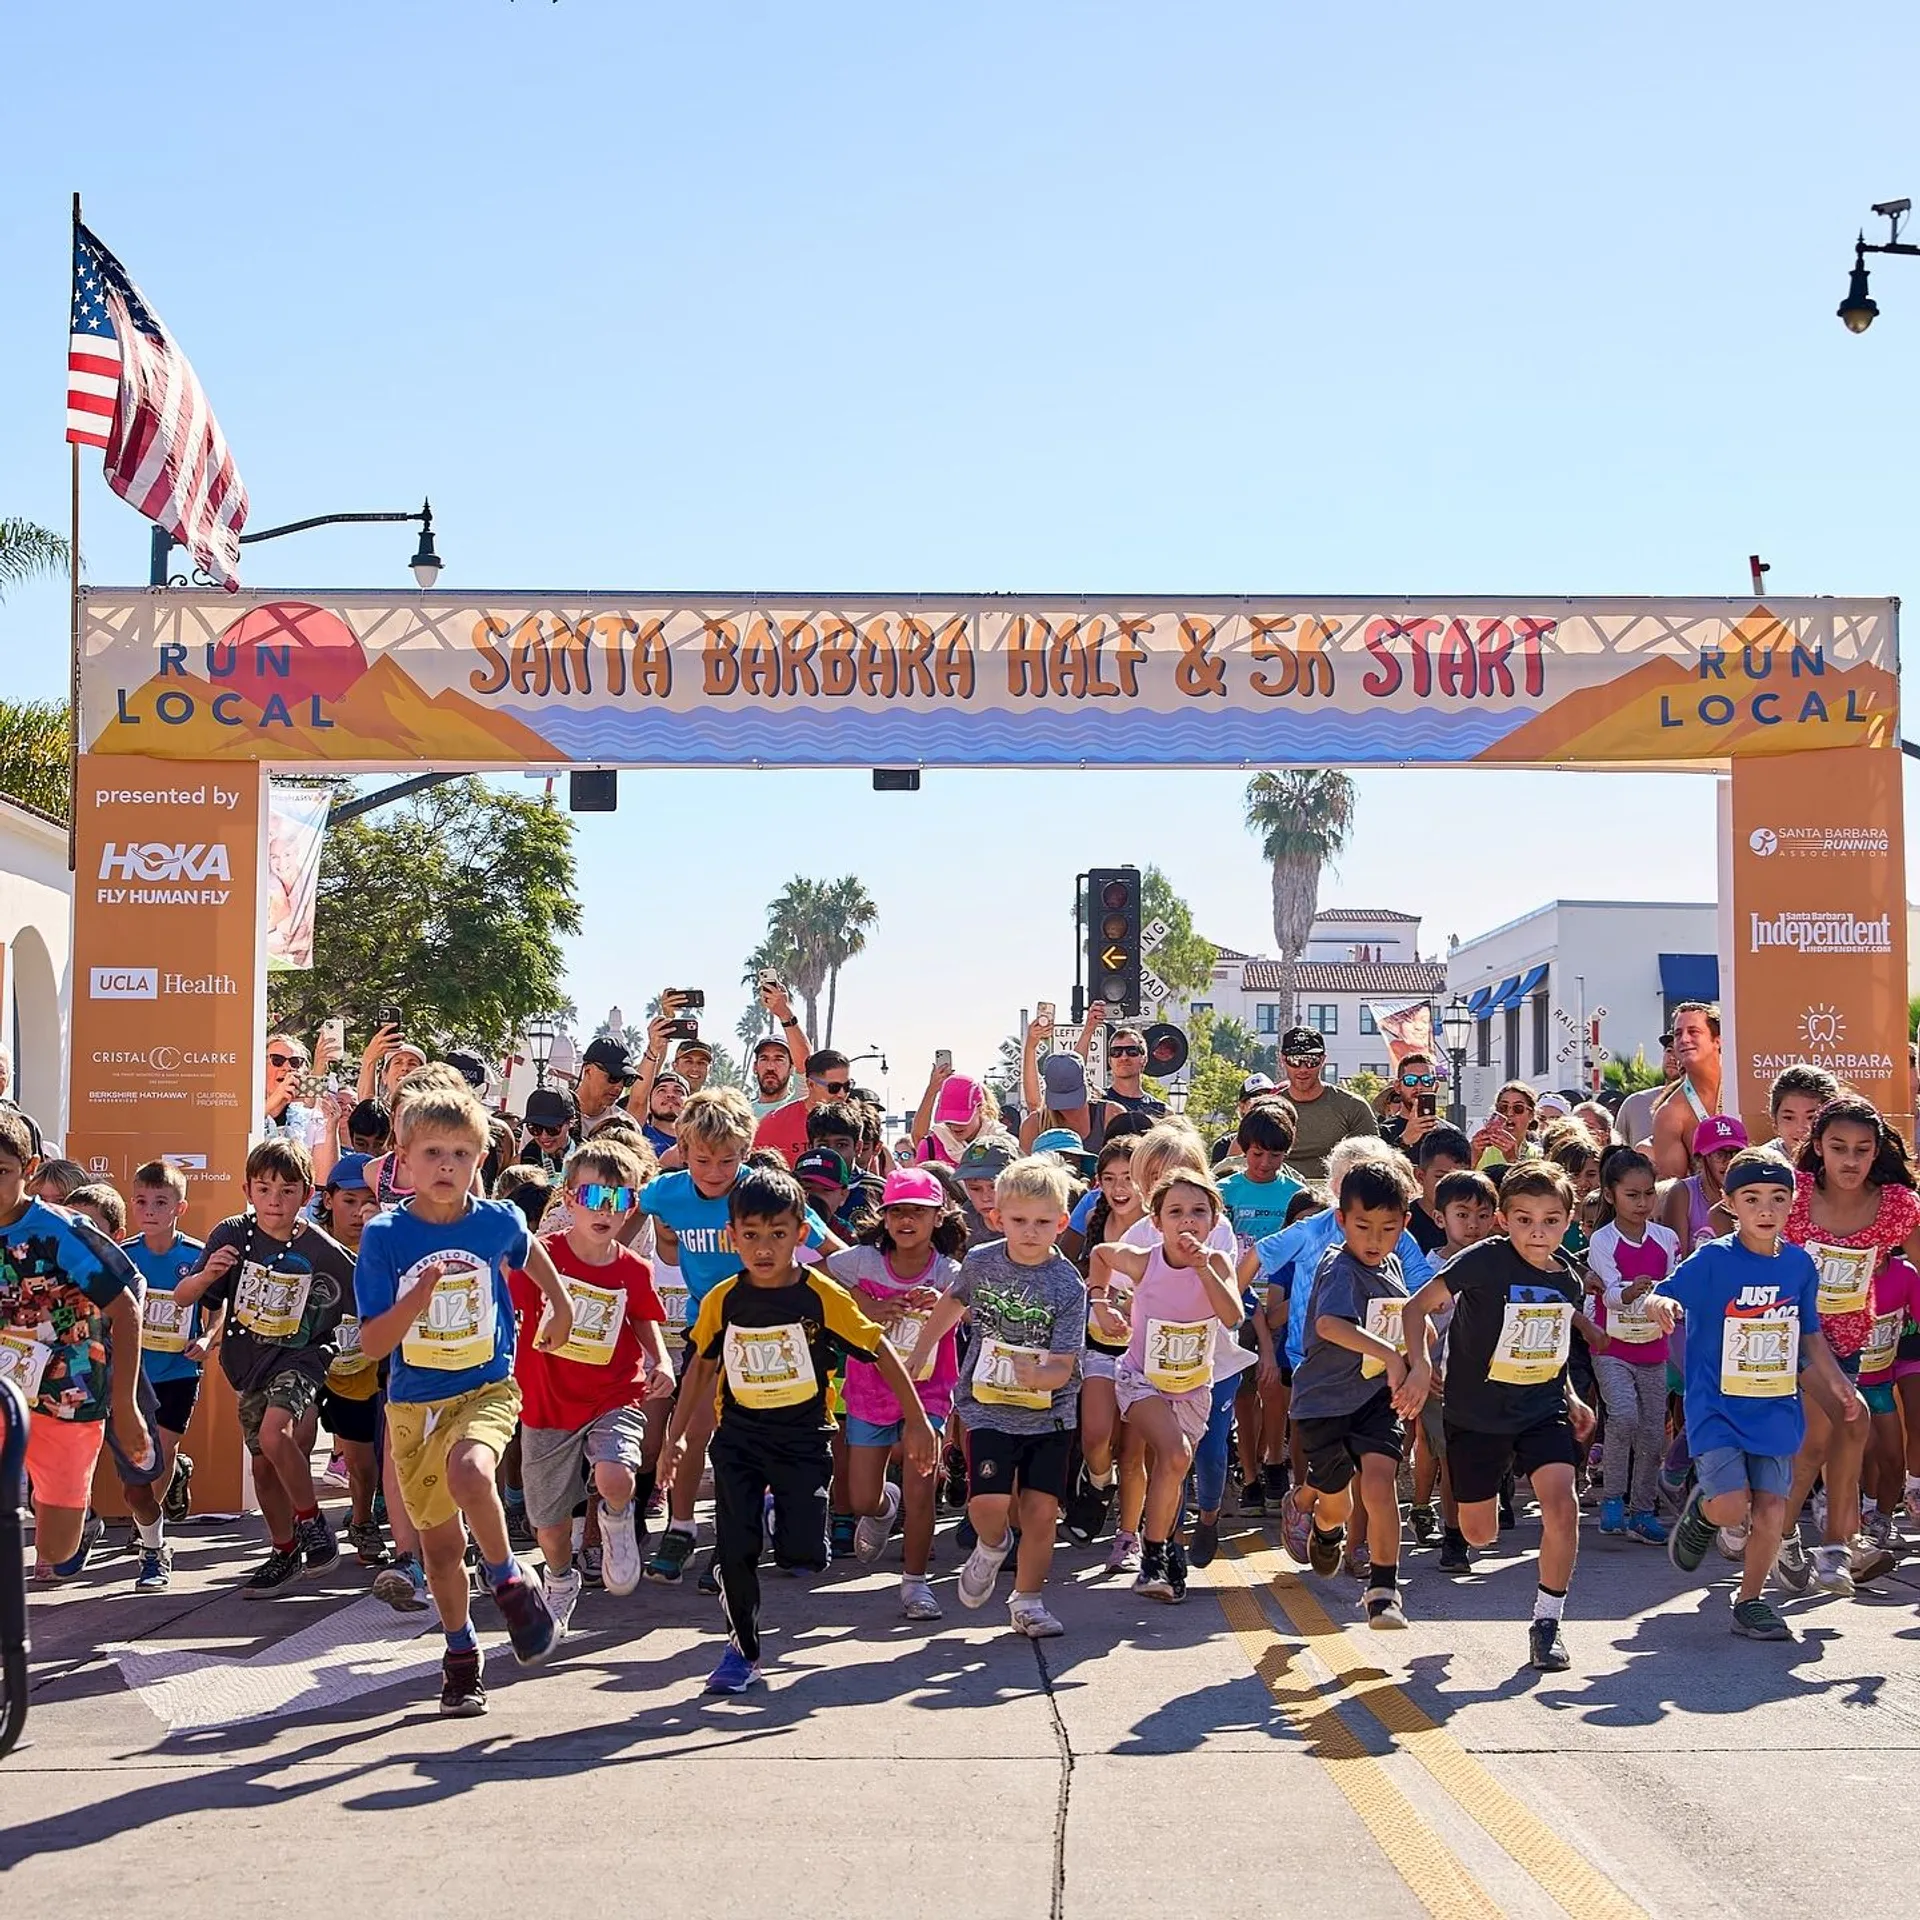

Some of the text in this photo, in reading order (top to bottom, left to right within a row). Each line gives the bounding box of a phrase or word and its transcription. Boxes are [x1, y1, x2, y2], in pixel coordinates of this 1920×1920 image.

[160, 642, 291, 677] RUN
[469, 615, 1559, 699] SANTA BARBARA HALF & 5K START
[1699, 644, 1826, 680] RUN
[116, 688, 335, 728] LOCAL
[1659, 689, 1868, 728] LOCAL
[95, 786, 240, 809] presented by
[1778, 828, 1889, 839] SANTA BARBARA
[1778, 850, 1888, 858] ASSOCIATION
[1823, 839, 1889, 851] RUNNING
[98, 842, 232, 882] HOKA
[97, 889, 231, 906] FLY HUMAN FLY
[1785, 912, 1847, 921] Santa Barbara
[1750, 912, 1891, 953] Independent
[99, 972, 238, 996] UCLA Health
[1054, 1029, 1076, 1038] LEFT
[92, 1051, 147, 1063] CRISTAL
[183, 1052, 236, 1064] CLARKE
[1752, 1054, 1893, 1068] SANTA BARBARA
[89, 1091, 188, 1099] BERKSHIRE HATHAWAY
[1715, 1121, 1732, 1136] LA
[202, 1172, 231, 1181] Honda
[416, 1251, 460, 1271] APOLLO
[1736, 1286, 1780, 1306] JUST
[1503, 1318, 1566, 1351] 2023
[728, 1340, 806, 1373] 2023
[1728, 1331, 1795, 1362] 2023
